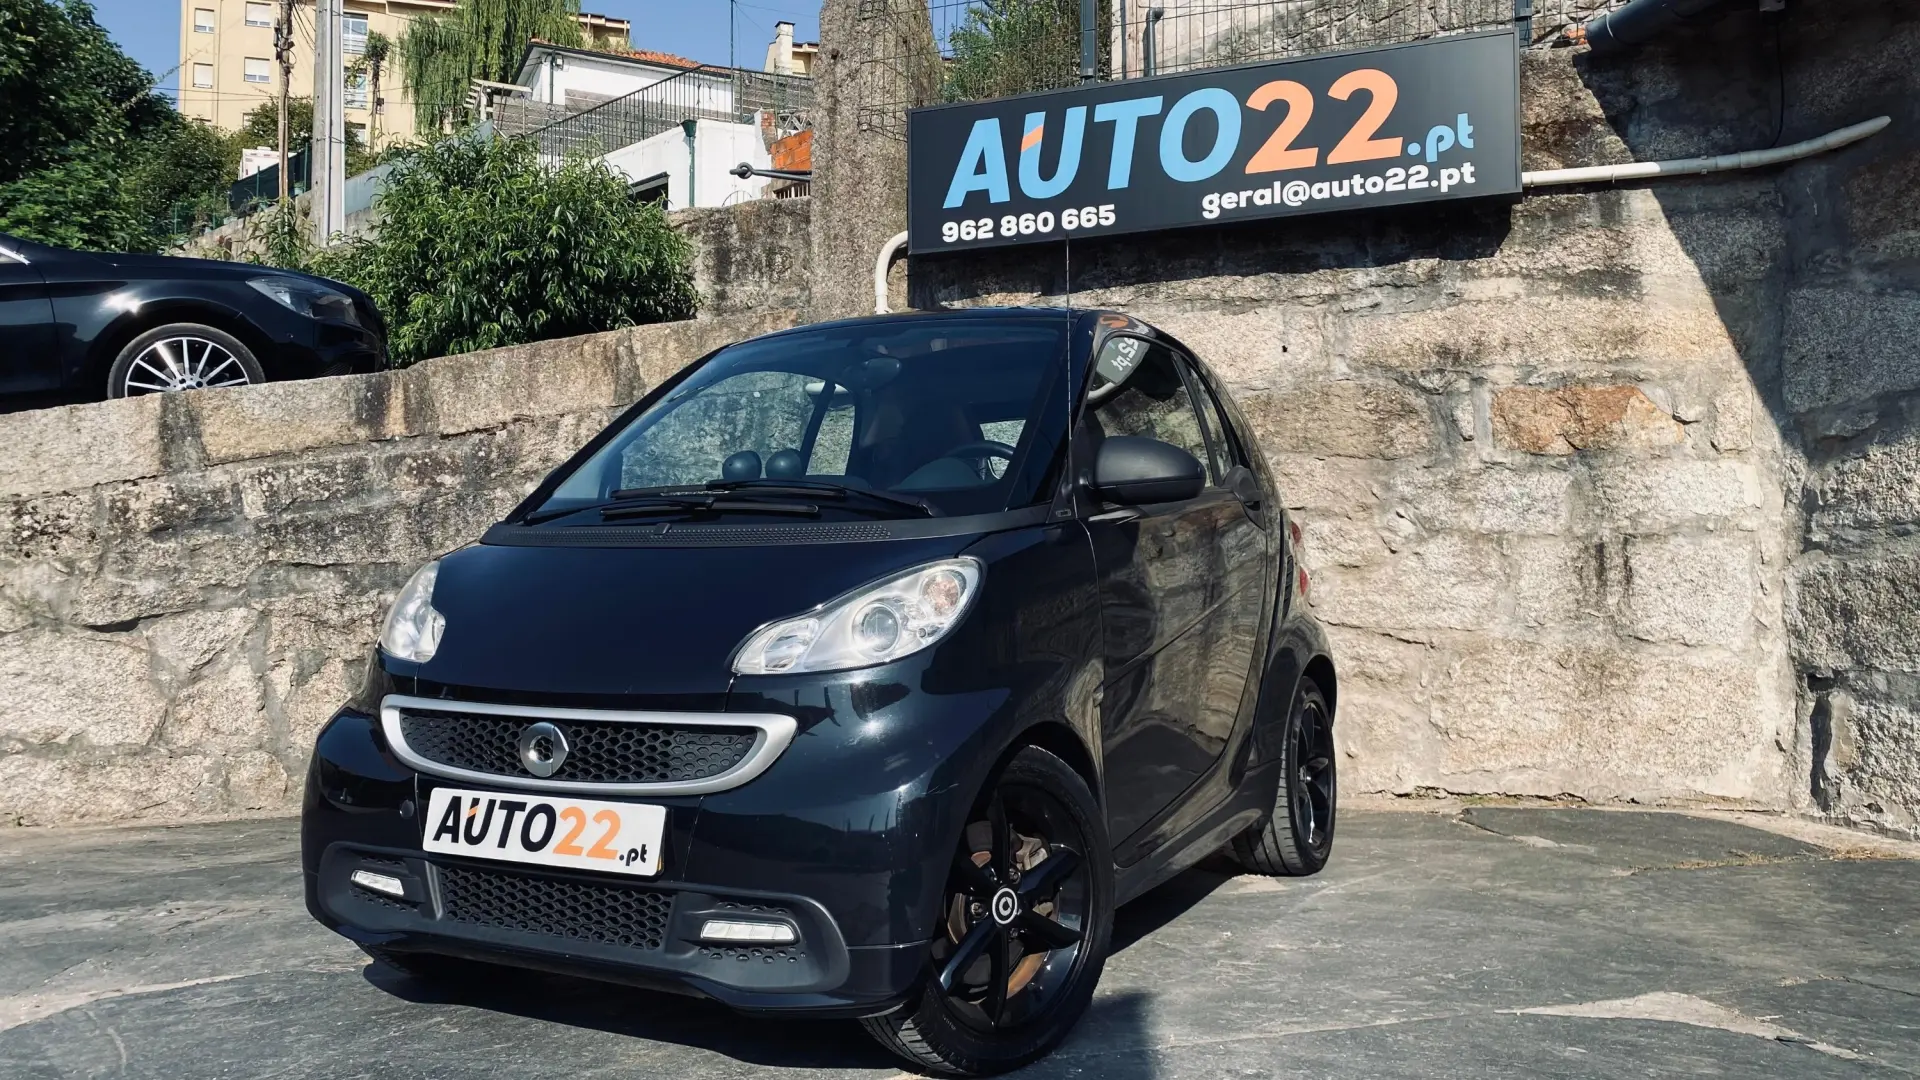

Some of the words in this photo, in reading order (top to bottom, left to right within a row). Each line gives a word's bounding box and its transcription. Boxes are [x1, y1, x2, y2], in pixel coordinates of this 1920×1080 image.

[942, 68, 1475, 209] AUTO22.pt
[1201, 161, 1476, 219] geral@auto22.pt
[942, 217, 994, 243] 962
[1000, 211, 1055, 237] 860
[1061, 203, 1116, 230] 665
[432, 795, 648, 867] AUTO22.pt
